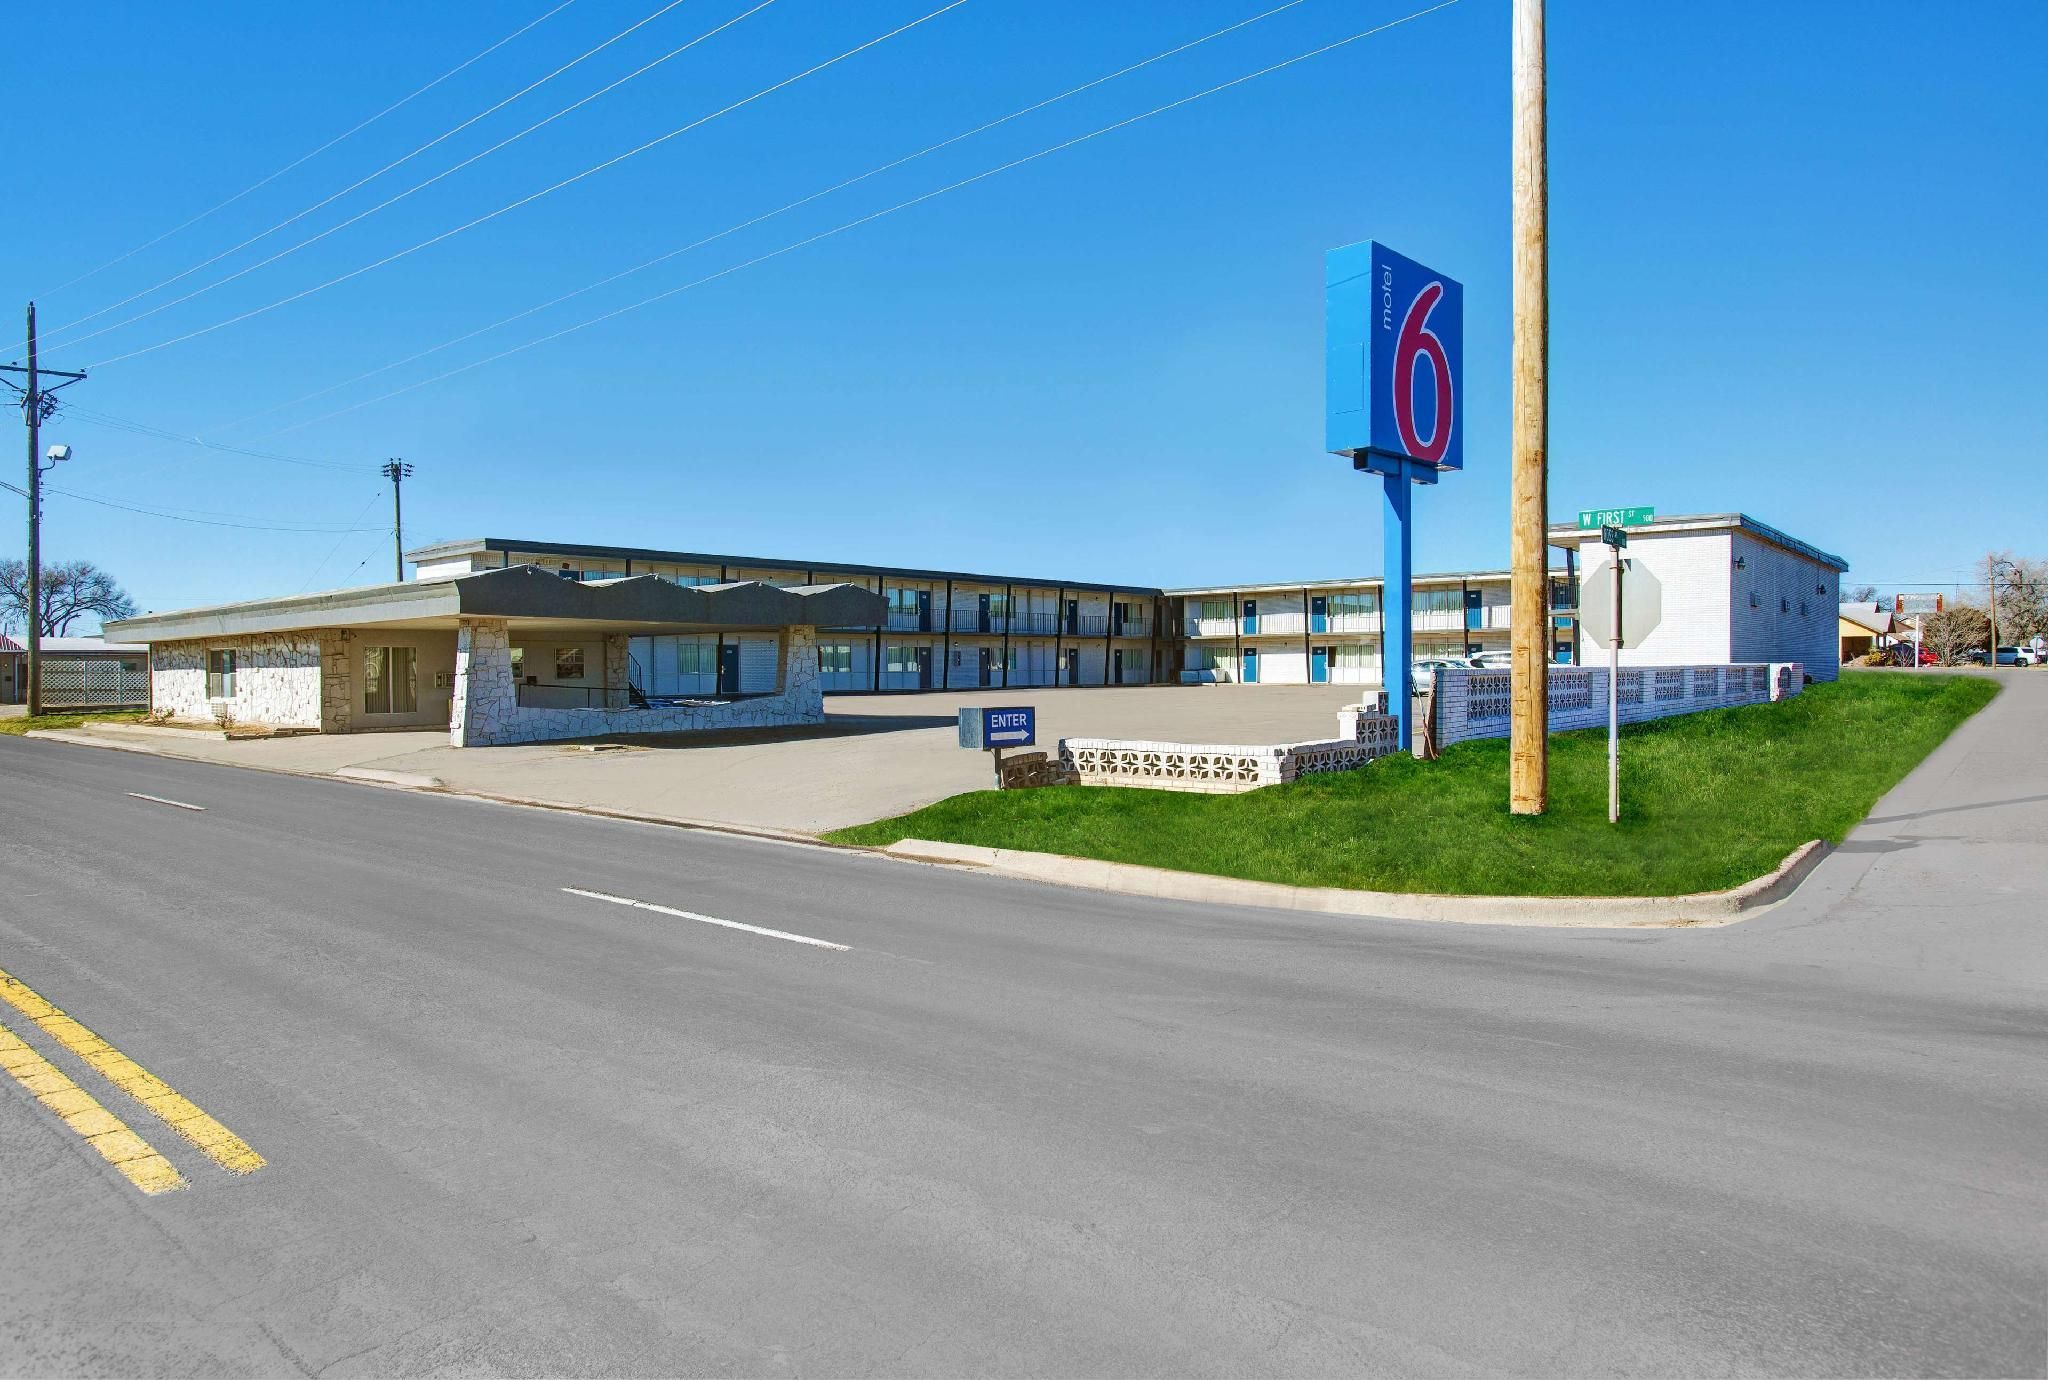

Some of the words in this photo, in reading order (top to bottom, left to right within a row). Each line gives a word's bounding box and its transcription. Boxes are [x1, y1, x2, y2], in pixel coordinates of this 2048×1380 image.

[1382, 264, 1392, 331] motel
[1392, 280, 1454, 463] 6
[1583, 513, 1592, 526] W
[1597, 510, 1625, 525] FIRST
[991, 713, 1027, 728] ENTER
